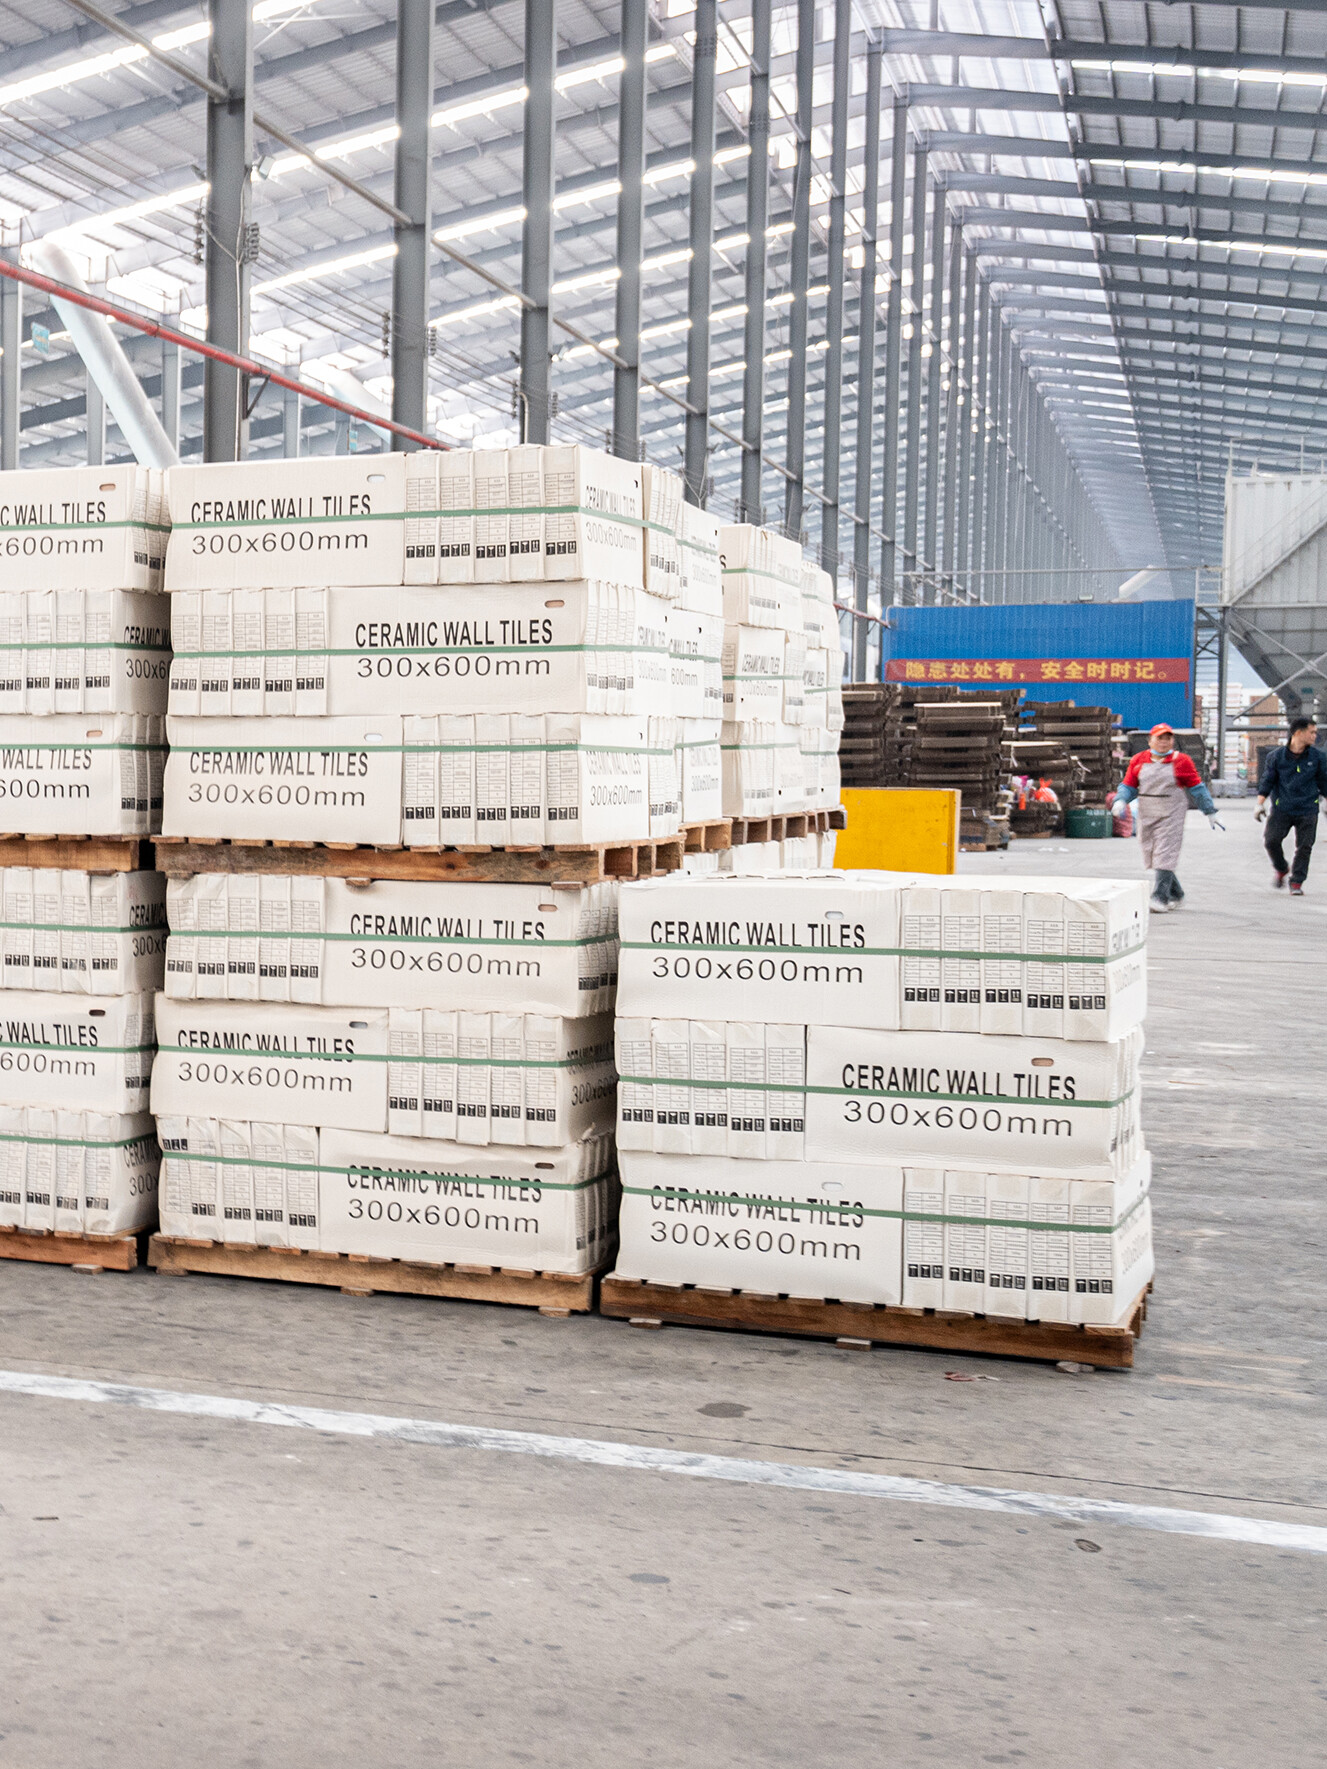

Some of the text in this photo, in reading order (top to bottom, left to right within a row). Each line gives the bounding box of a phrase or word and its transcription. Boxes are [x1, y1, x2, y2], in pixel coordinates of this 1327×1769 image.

[14, 503, 57, 526] WALL
[61, 501, 106, 523] TILES
[191, 499, 266, 523] CERAMIC
[322, 494, 371, 516] TILES
[192, 531, 368, 555] 300x600mm
[586, 521, 636, 551] 300x600mm
[355, 621, 438, 648] CERAMIC
[444, 621, 494, 646] WALL
[500, 618, 553, 645] TILES
[357, 655, 550, 678] 300x600mm
[2, 749, 43, 769] WALL
[49, 749, 92, 769] TILES
[189, 751, 368, 777] CERAMIC WALL TILES
[188, 783, 365, 806] 300x600mm
[590, 785, 642, 806] 300x600mm
[350, 913, 433, 938] CERAMIC
[492, 919, 545, 942] TILES
[651, 920, 866, 950] CERAMIC WALL TILES
[351, 948, 542, 977] 300x600mm
[652, 956, 864, 984] 300x600mm
[6, 1020, 49, 1045] WALL
[54, 1024, 98, 1048] TILES
[178, 1029, 355, 1063] CERAMIC WALL TILES
[178, 1062, 354, 1092] 300x600mm
[842, 1063, 1076, 1101] CERAMIC WALL TILES
[843, 1100, 1073, 1137] 300x600mm
[347, 1164, 542, 1203] CERAMIC WALL TILES
[347, 1199, 540, 1234] 300x600mm
[651, 1184, 865, 1229] CERAMIC WALL TILES
[650, 1220, 862, 1261] 300x600mm
